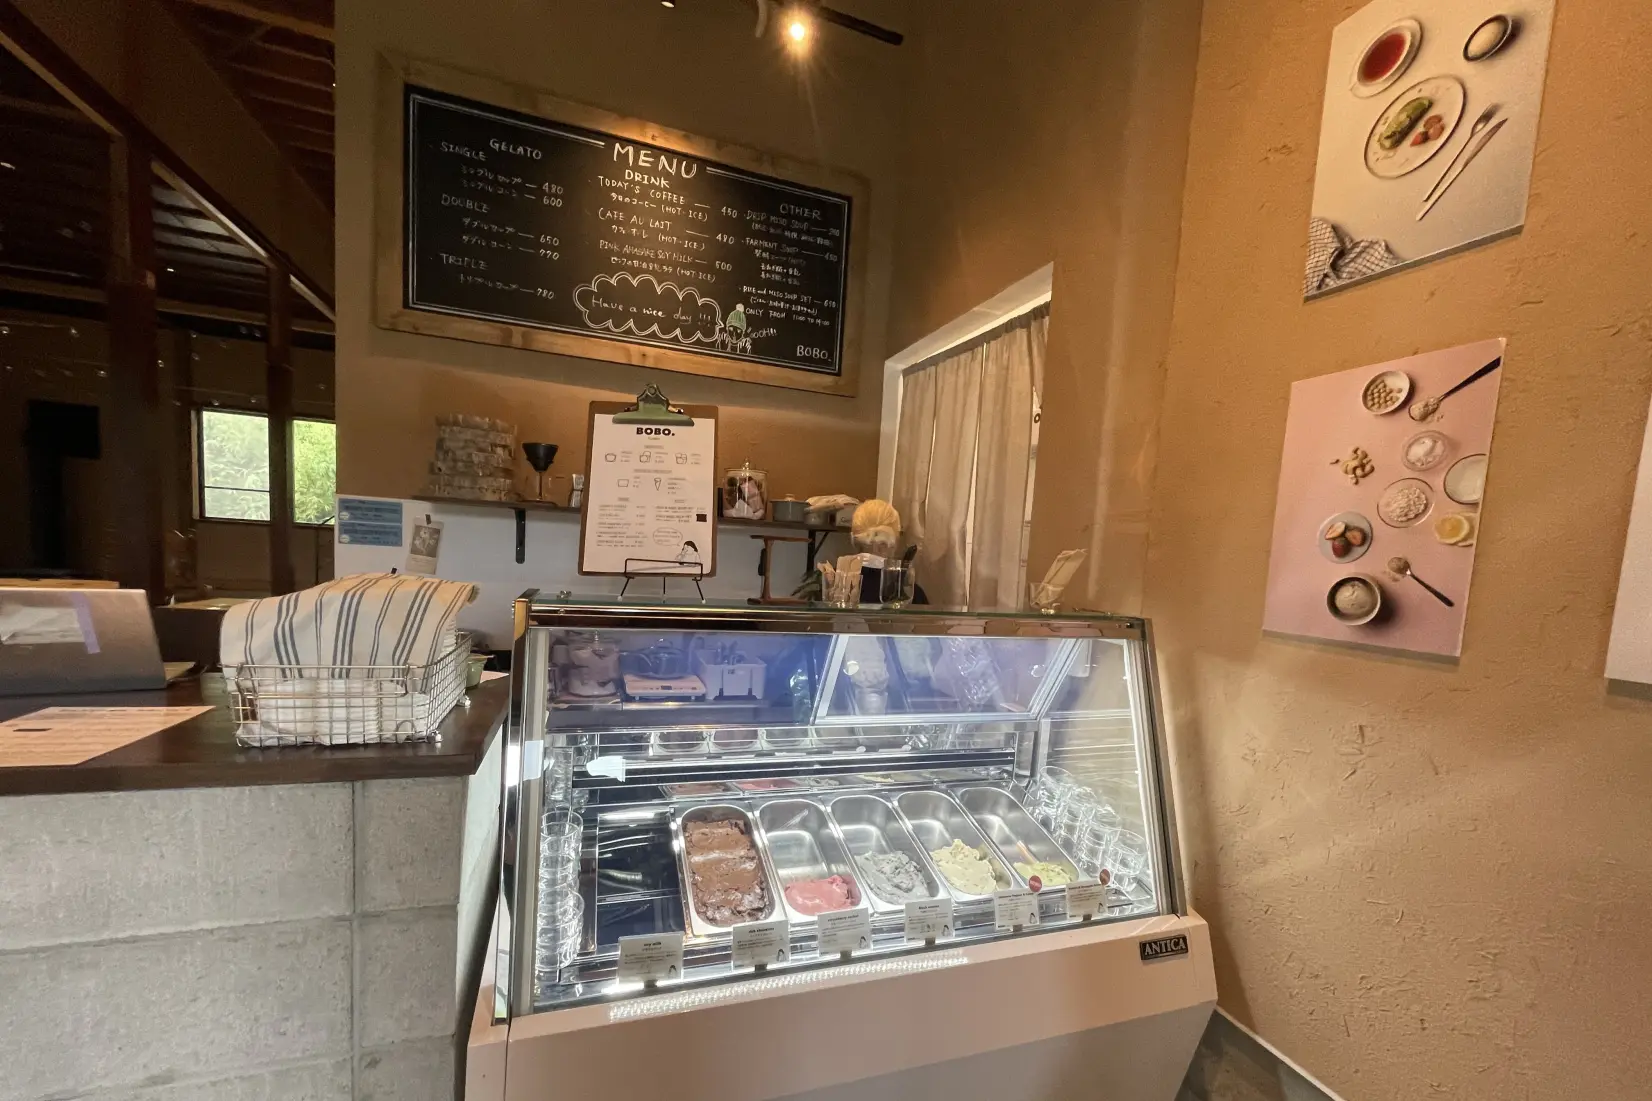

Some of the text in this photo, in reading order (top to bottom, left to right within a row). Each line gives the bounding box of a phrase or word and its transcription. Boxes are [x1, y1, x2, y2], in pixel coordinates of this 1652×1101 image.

[440, 142, 487, 161] SINGLE
[489, 138, 542, 160] GELATO
[613, 142, 697, 178] MENU
[624, 169, 670, 188] DRINK
[542, 182, 564, 194] 480
[598, 175, 738, 219] TODAY'S COFFEE 450
[441, 193, 490, 213] DOUBLE
[543, 196, 563, 207] 600
[779, 203, 822, 221] OTHER
[598, 207, 735, 245] CAFE AU LAIT 480
[540, 234, 559, 246] 650
[540, 249, 559, 260] 770
[600, 239, 620, 251] PINK
[657, 250, 670, 259] SOY
[672, 252, 693, 263] MILK
[440, 253, 488, 270] TRIPLE
[537, 288, 555, 300] 780
[592, 295, 623, 312] Have
[629, 304, 638, 313] a
[642, 306, 666, 318] nice
[673, 307, 692, 324] day
[745, 307, 764, 317] ONLY
[768, 310, 786, 318] FROM
[636, 427, 675, 437] BOBO.
[1144, 938, 1186, 955] ANTICA
